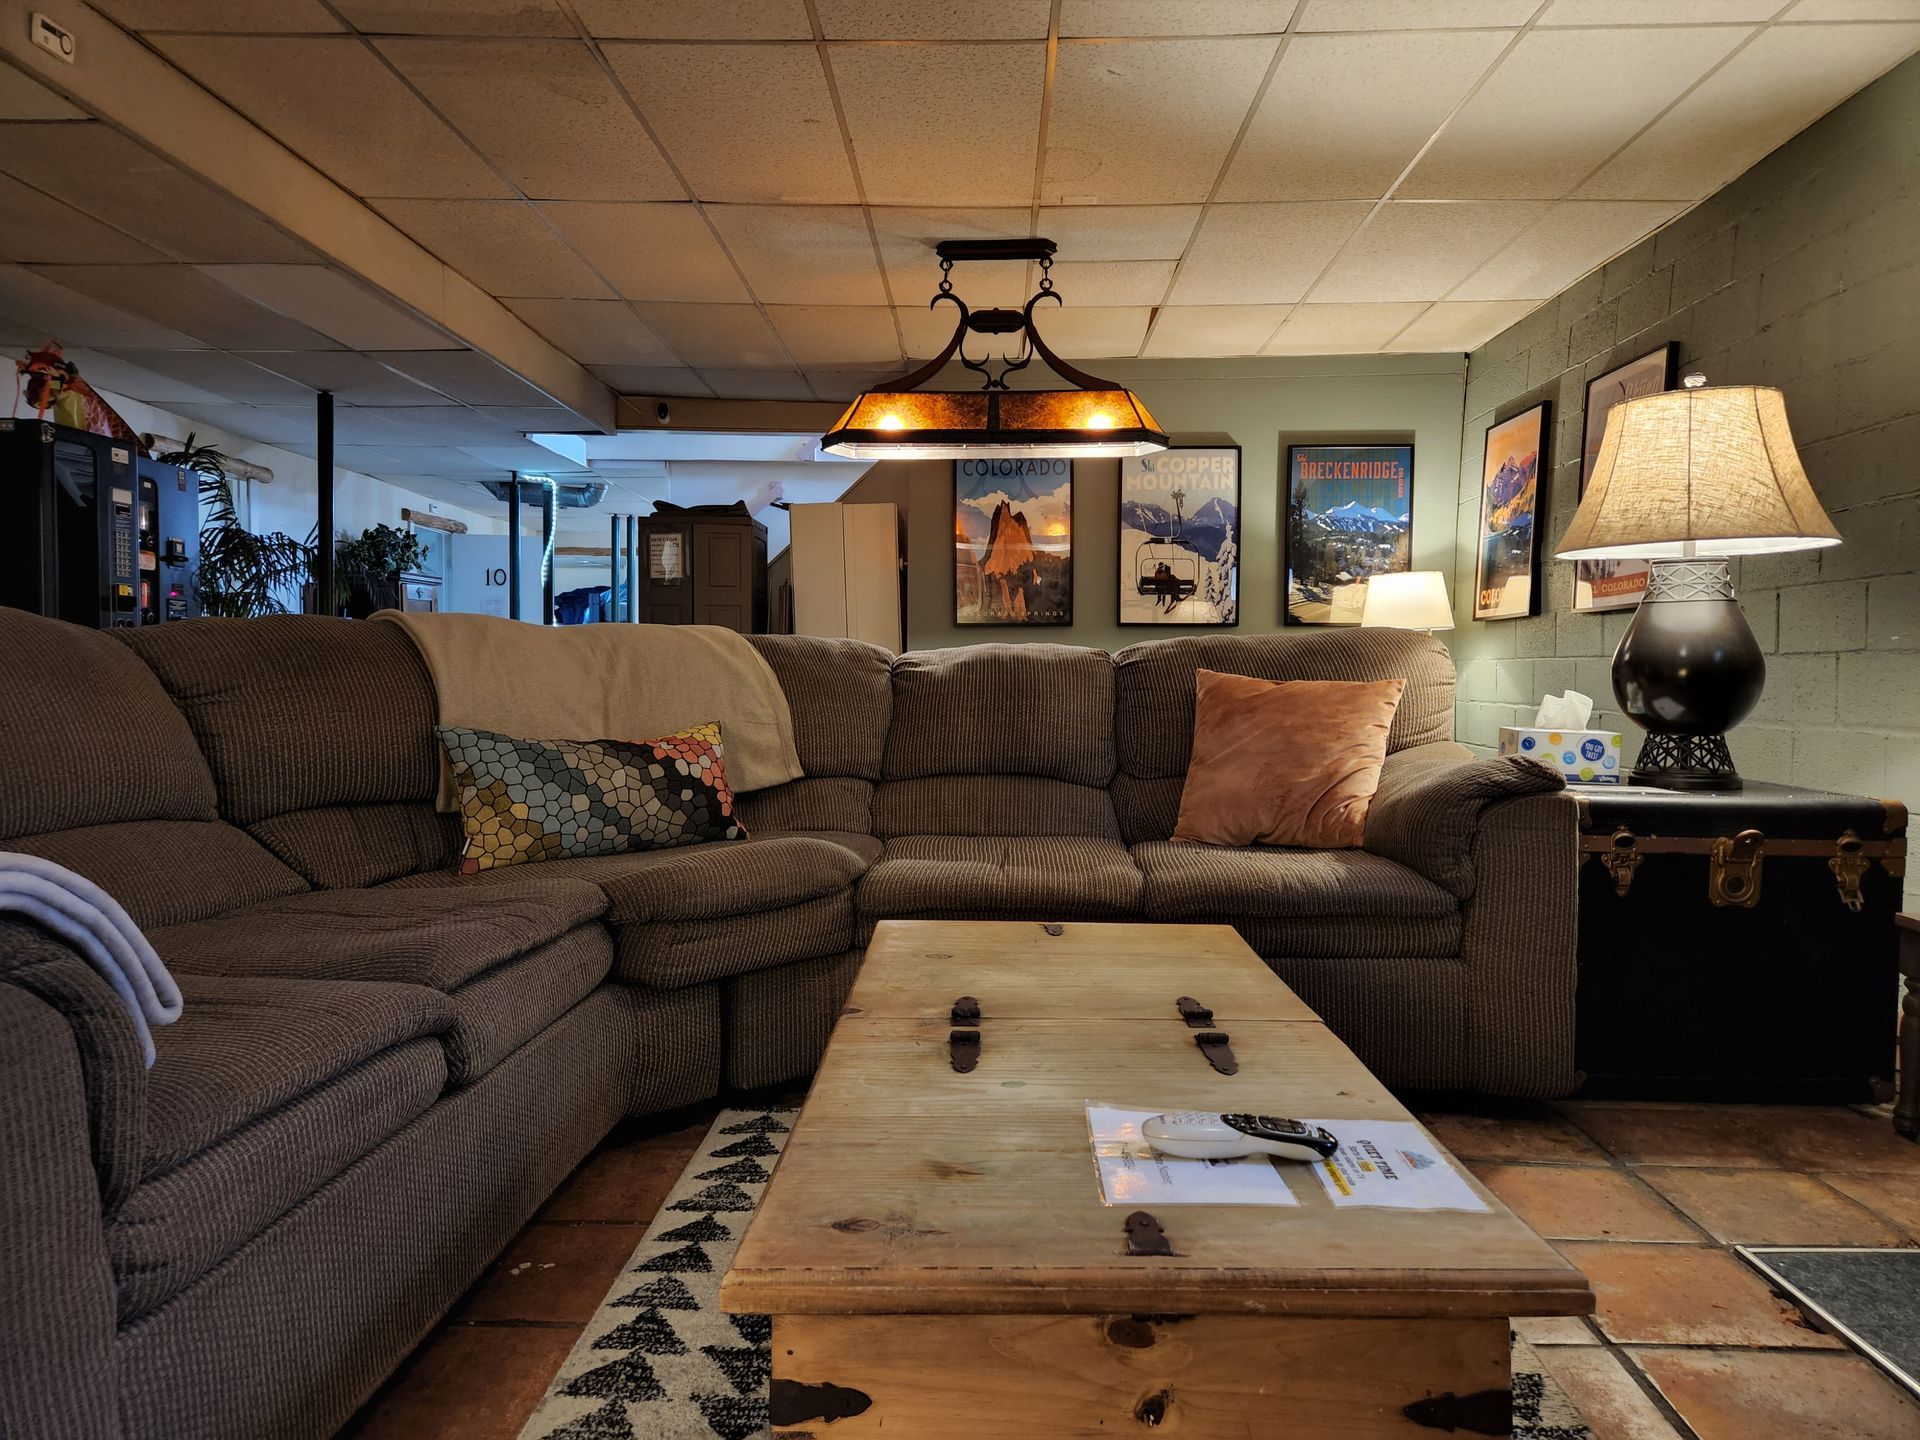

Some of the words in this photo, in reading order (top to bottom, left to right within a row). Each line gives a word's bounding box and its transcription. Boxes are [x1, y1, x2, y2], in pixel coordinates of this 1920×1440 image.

[962, 459, 1067, 477] COLORADO
[1141, 458, 1156, 472] Ski
[1157, 456, 1235, 474] COPPER
[1301, 461, 1399, 479] BRECKENRIDGE
[1126, 473, 1234, 490] MOUNTAIN
[486, 568, 507, 586] 10
[1601, 577, 1646, 593] COLORADO
[1356, 1139, 1384, 1160] QUIET
[1374, 1160, 1399, 1180] TIME
